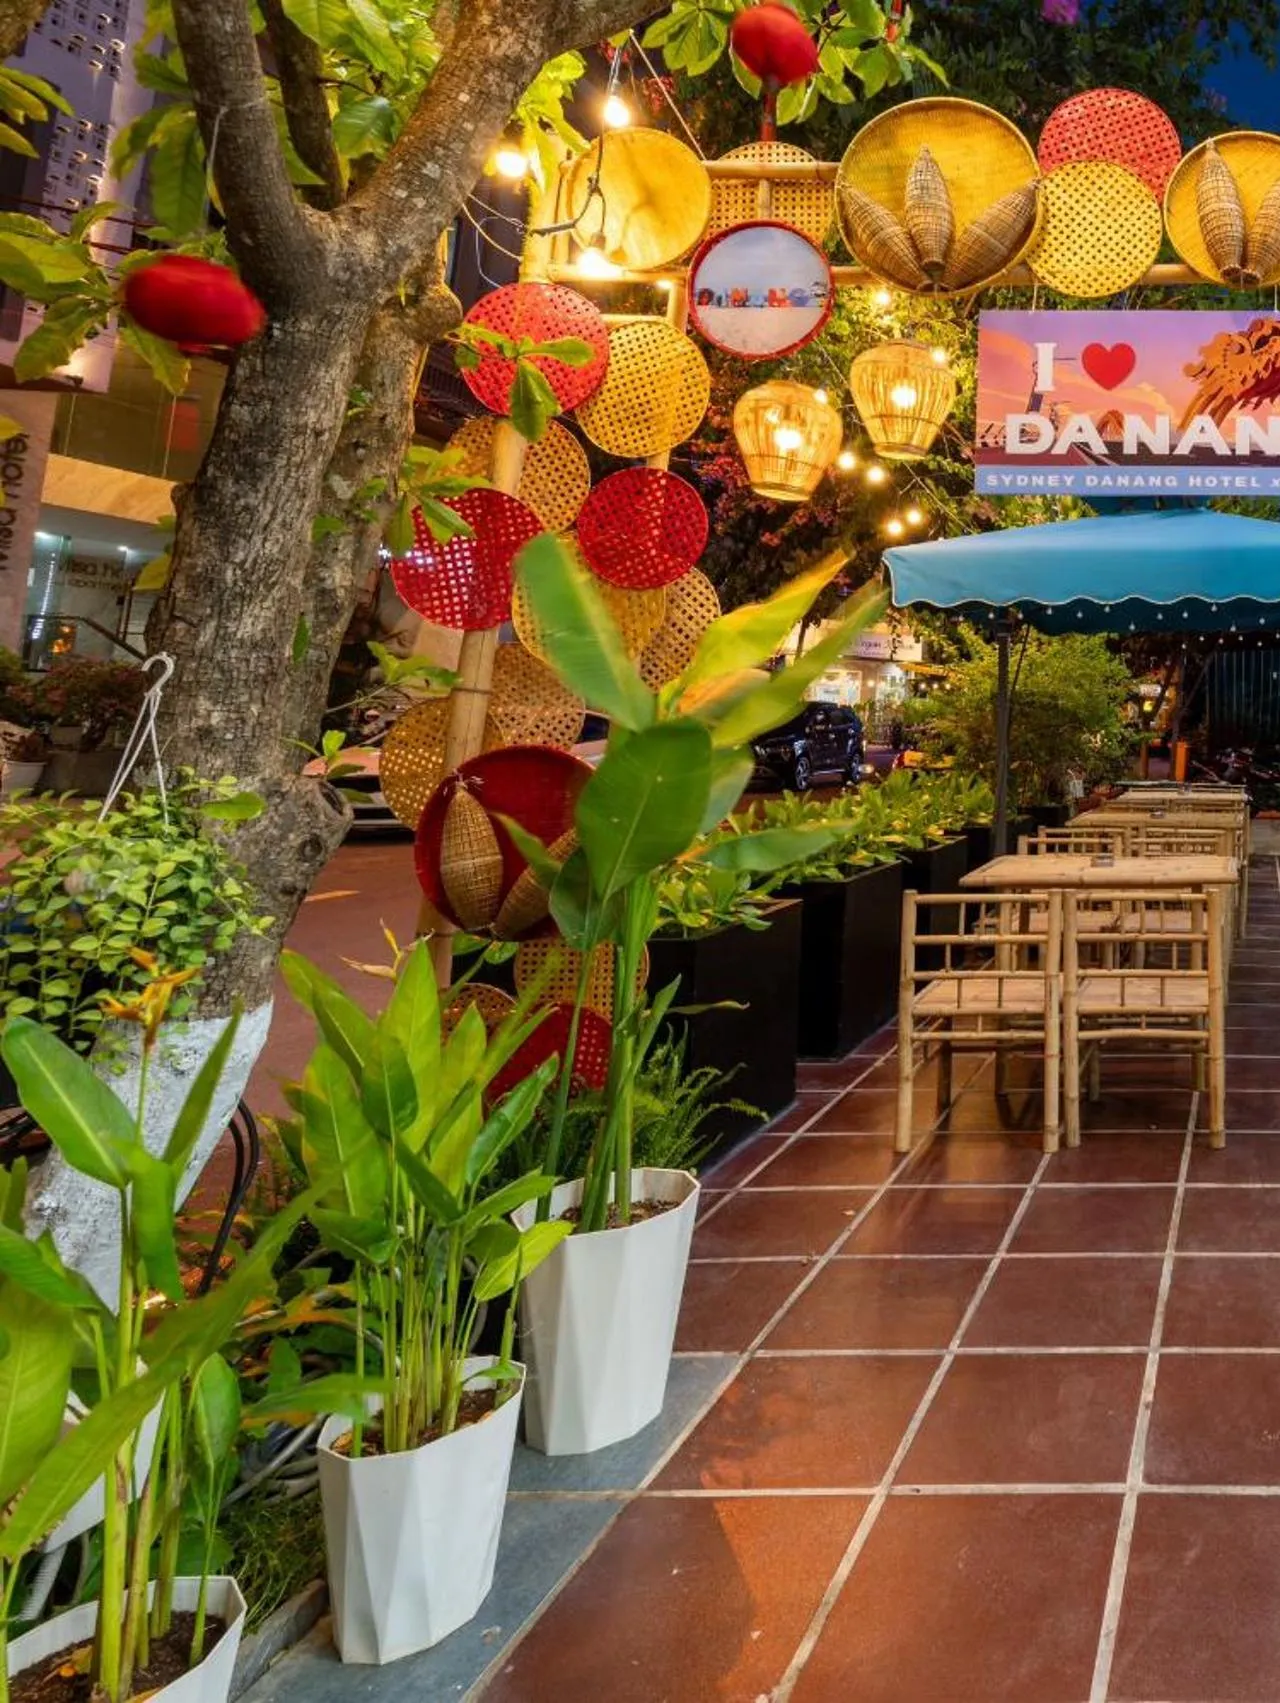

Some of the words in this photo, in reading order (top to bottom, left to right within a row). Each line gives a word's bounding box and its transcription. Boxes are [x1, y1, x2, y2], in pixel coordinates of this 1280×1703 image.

[1034, 341, 1057, 392] I
[985, 474, 1075, 488] SYDNEY
[1085, 474, 1179, 488] DANANG
[1188, 474, 1261, 488] HOTEL
